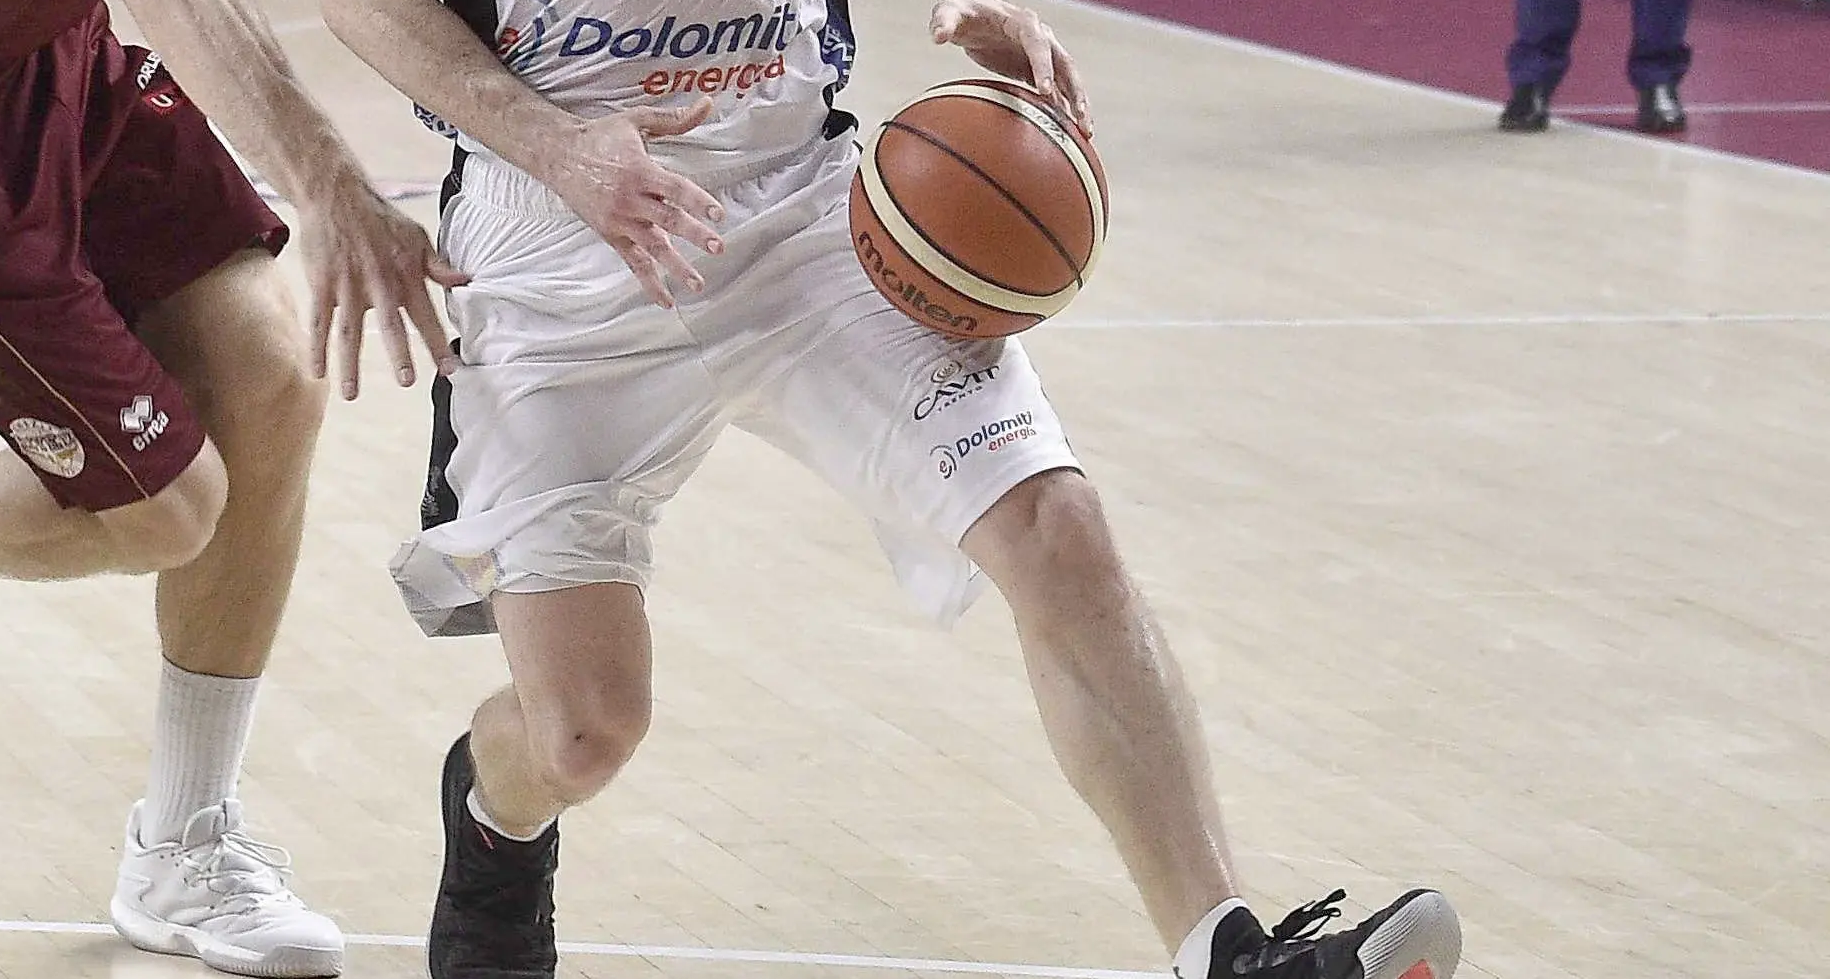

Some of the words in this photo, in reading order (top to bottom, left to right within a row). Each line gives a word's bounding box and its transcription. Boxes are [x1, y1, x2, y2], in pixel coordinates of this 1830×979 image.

[558, 2, 802, 59] Dolomit
[857, 230, 978, 331] molten
[913, 365, 1000, 421] CAVIT
[955, 410, 1033, 458] Dolomiti
